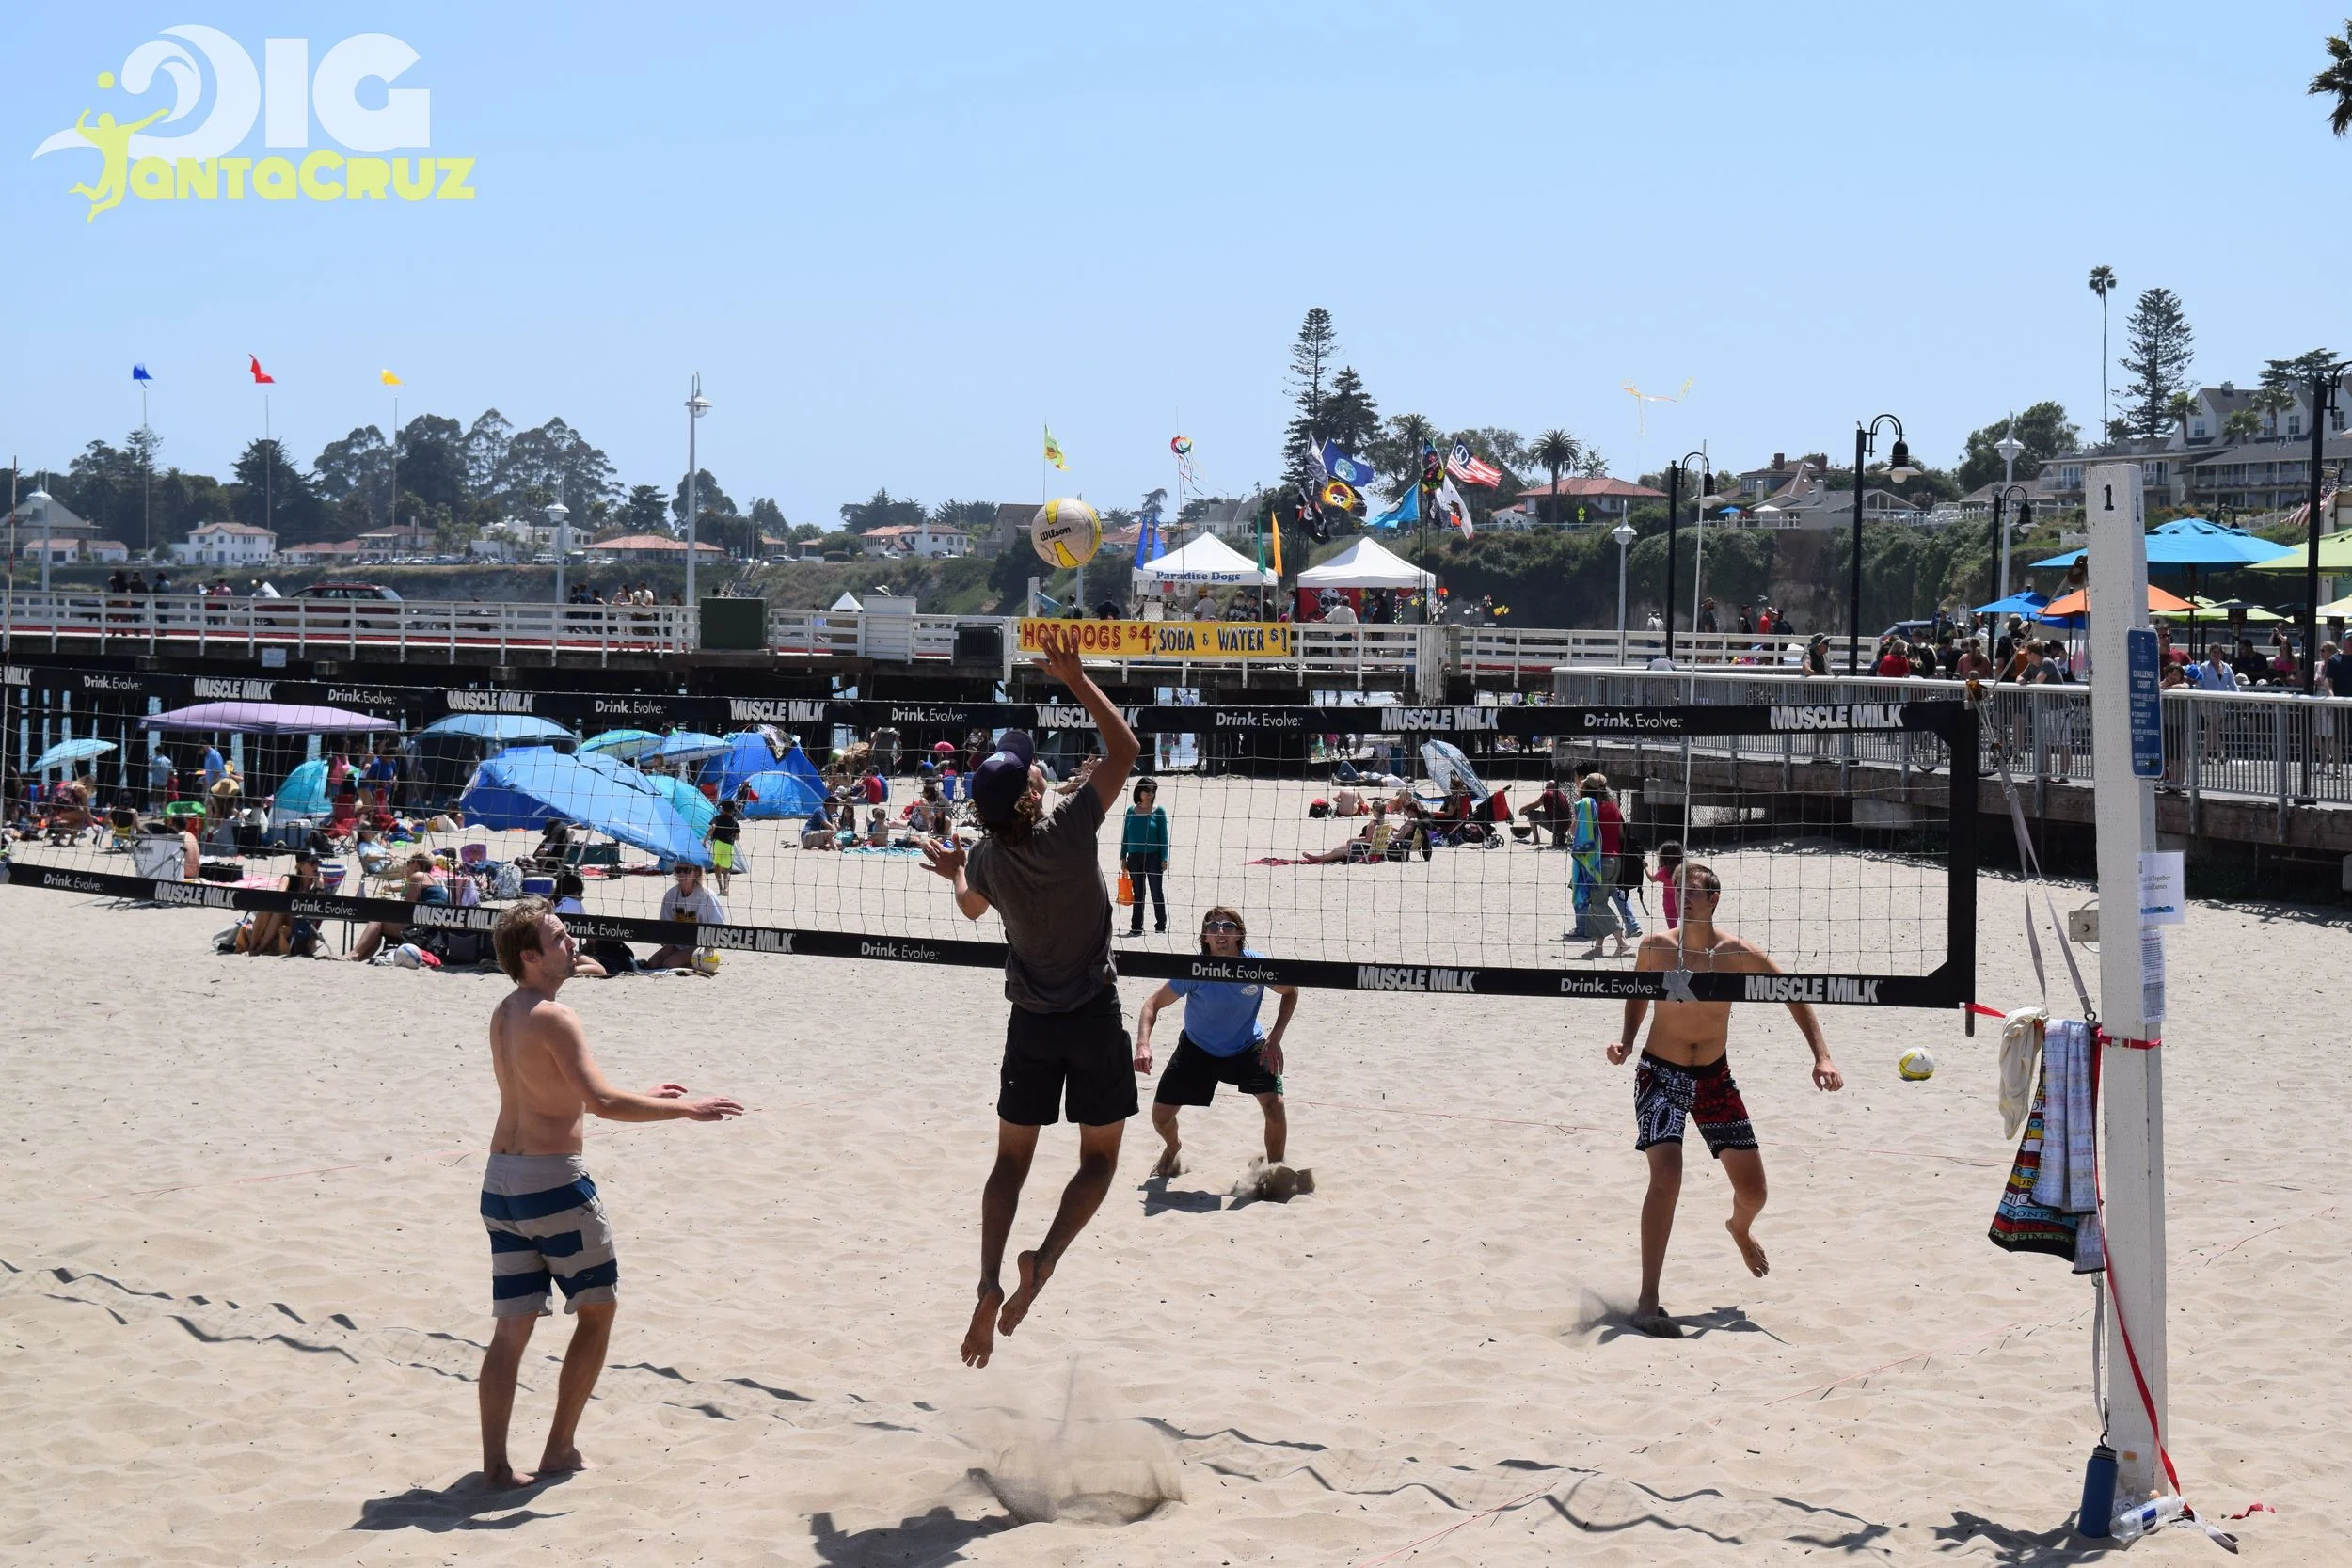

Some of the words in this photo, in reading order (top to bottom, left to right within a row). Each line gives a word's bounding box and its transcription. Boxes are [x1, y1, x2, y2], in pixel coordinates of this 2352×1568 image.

[2104, 484, 2115, 511] 1
[1040, 527, 1072, 542] Wilson
[1156, 571, 1208, 580] Paradise
[1211, 572, 1241, 582] Dogs
[1023, 622, 1060, 648] HOT
[1071, 624, 1121, 651] DOGS
[1128, 624, 1152, 652] $4
[1159, 626, 1195, 651] SODA
[1202, 632, 1210, 647] &
[1217, 626, 1265, 652] WATER
[1269, 627, 1287, 653] $1
[4, 666, 31, 685] MILK
[84, 675, 111, 689] Drink.
[194, 677, 242, 699] MUSCLE
[242, 678, 272, 700] MILK
[328, 689, 362, 703] Drink.
[447, 691, 498, 712] MUSCLE
[499, 693, 533, 713] MILK
[596, 700, 632, 713] Drink.
[730, 699, 787, 721] MUSCLE
[789, 701, 824, 721] MILK
[891, 707, 928, 721] Drink.
[1216, 712, 1261, 726] Drink.
[1381, 707, 1451, 731] MUSCLE
[1454, 707, 1499, 730] MILK
[1584, 712, 1633, 727] Drink.
[1770, 705, 1848, 730] MUSCLE
[1851, 703, 1903, 728] MILK
[43, 874, 72, 889] Drink.
[155, 881, 202, 904] MUSCLE
[204, 885, 235, 908] MILK
[292, 899, 323, 913] Drink.
[413, 904, 465, 927] MUSCLE
[696, 926, 754, 949] MUSCLE
[755, 929, 793, 953] MILK
[861, 942, 899, 958] Drink.
[1192, 963, 1234, 978] Drink.
[1357, 965, 1427, 990] MUSCLE
[1429, 968, 1475, 992] MILK
[1561, 977, 1609, 993] Drink.
[1745, 975, 1824, 1001] MUSCLE
[1827, 976, 1879, 1003] MILK
